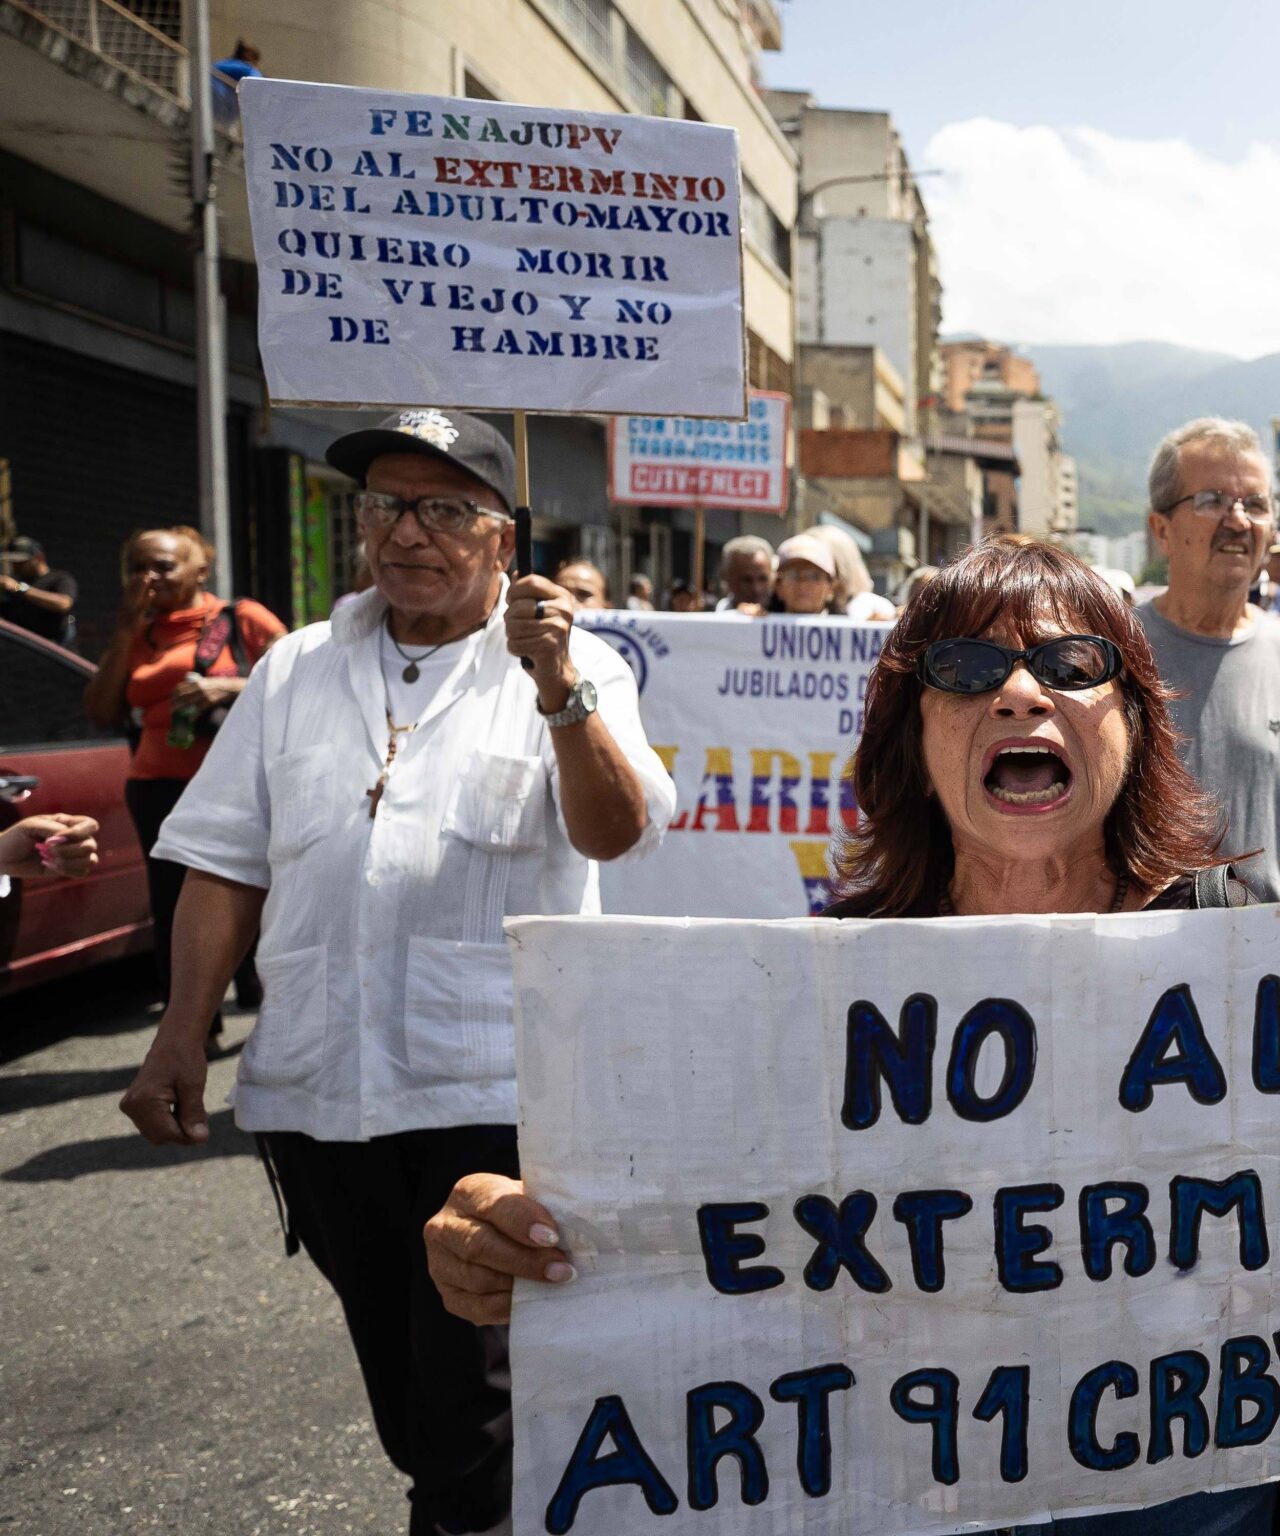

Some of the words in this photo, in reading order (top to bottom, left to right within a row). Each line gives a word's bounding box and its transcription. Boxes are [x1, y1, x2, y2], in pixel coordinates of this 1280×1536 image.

[369, 108, 622, 155] FENAJUPV
[270, 143, 333, 173] NO
[351, 150, 416, 179] AL
[433, 155, 726, 203] EXTERMINIO
[275, 181, 371, 214] DEL
[278, 229, 471, 269] QUIERO
[516, 247, 670, 281] MORIR
[281, 269, 343, 299] DE
[382, 278, 538, 317] VIEJO
[559, 294, 591, 321] Y
[616, 298, 672, 326] NO
[329, 317, 390, 345] DE
[452, 326, 660, 361] HAMBRE
[761, 624, 843, 662] UNION
[850, 629, 884, 662] NA
[718, 668, 849, 701] JUBILADOS
[840, 993, 1037, 1131] NO
[544, 1363, 856, 1536] ART
[888, 1365, 1031, 1486] 91
